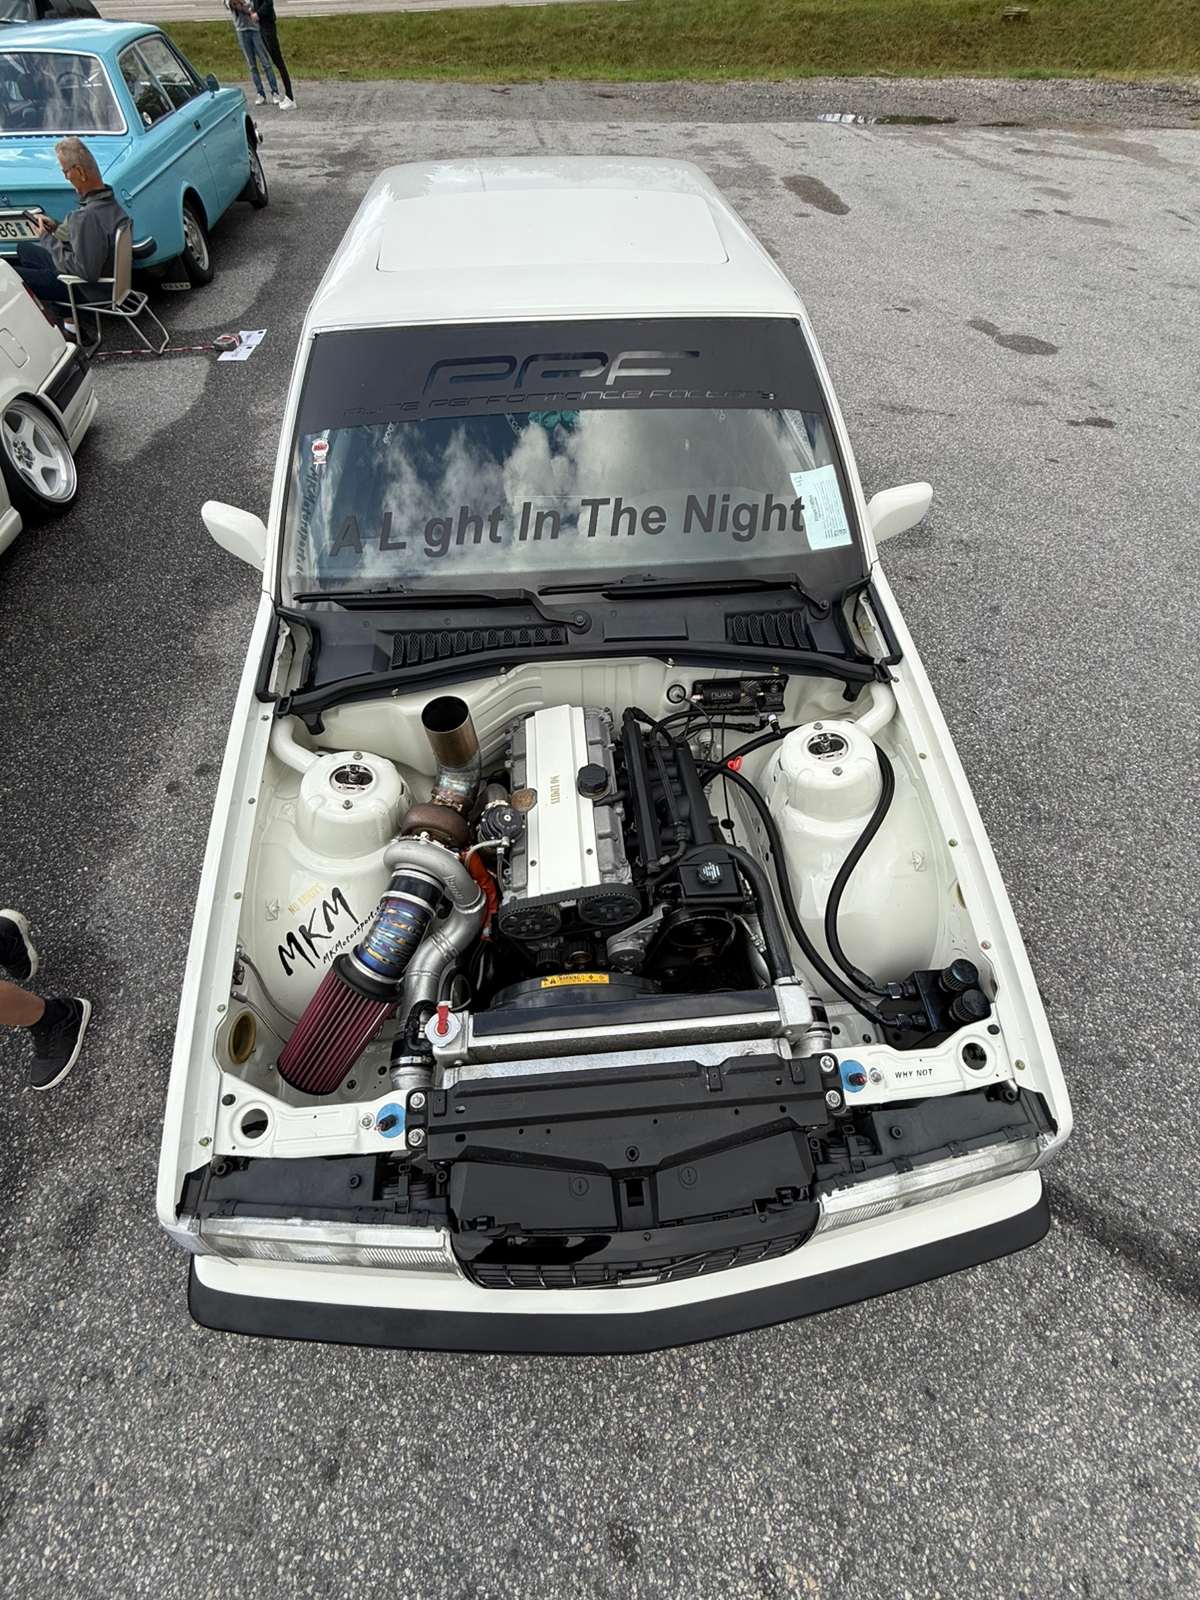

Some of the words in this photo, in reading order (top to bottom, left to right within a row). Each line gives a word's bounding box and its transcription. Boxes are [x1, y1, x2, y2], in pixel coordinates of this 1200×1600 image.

[421, 350, 700, 395] PPF
[329, 514, 363, 557] A
[518, 501, 561, 541] In
[581, 497, 667, 537] The
[683, 493, 805, 542] Night
[277, 886, 360, 976] MKM
[894, 1070, 913, 1079] WHY
[916, 1068, 933, 1077] NOT
